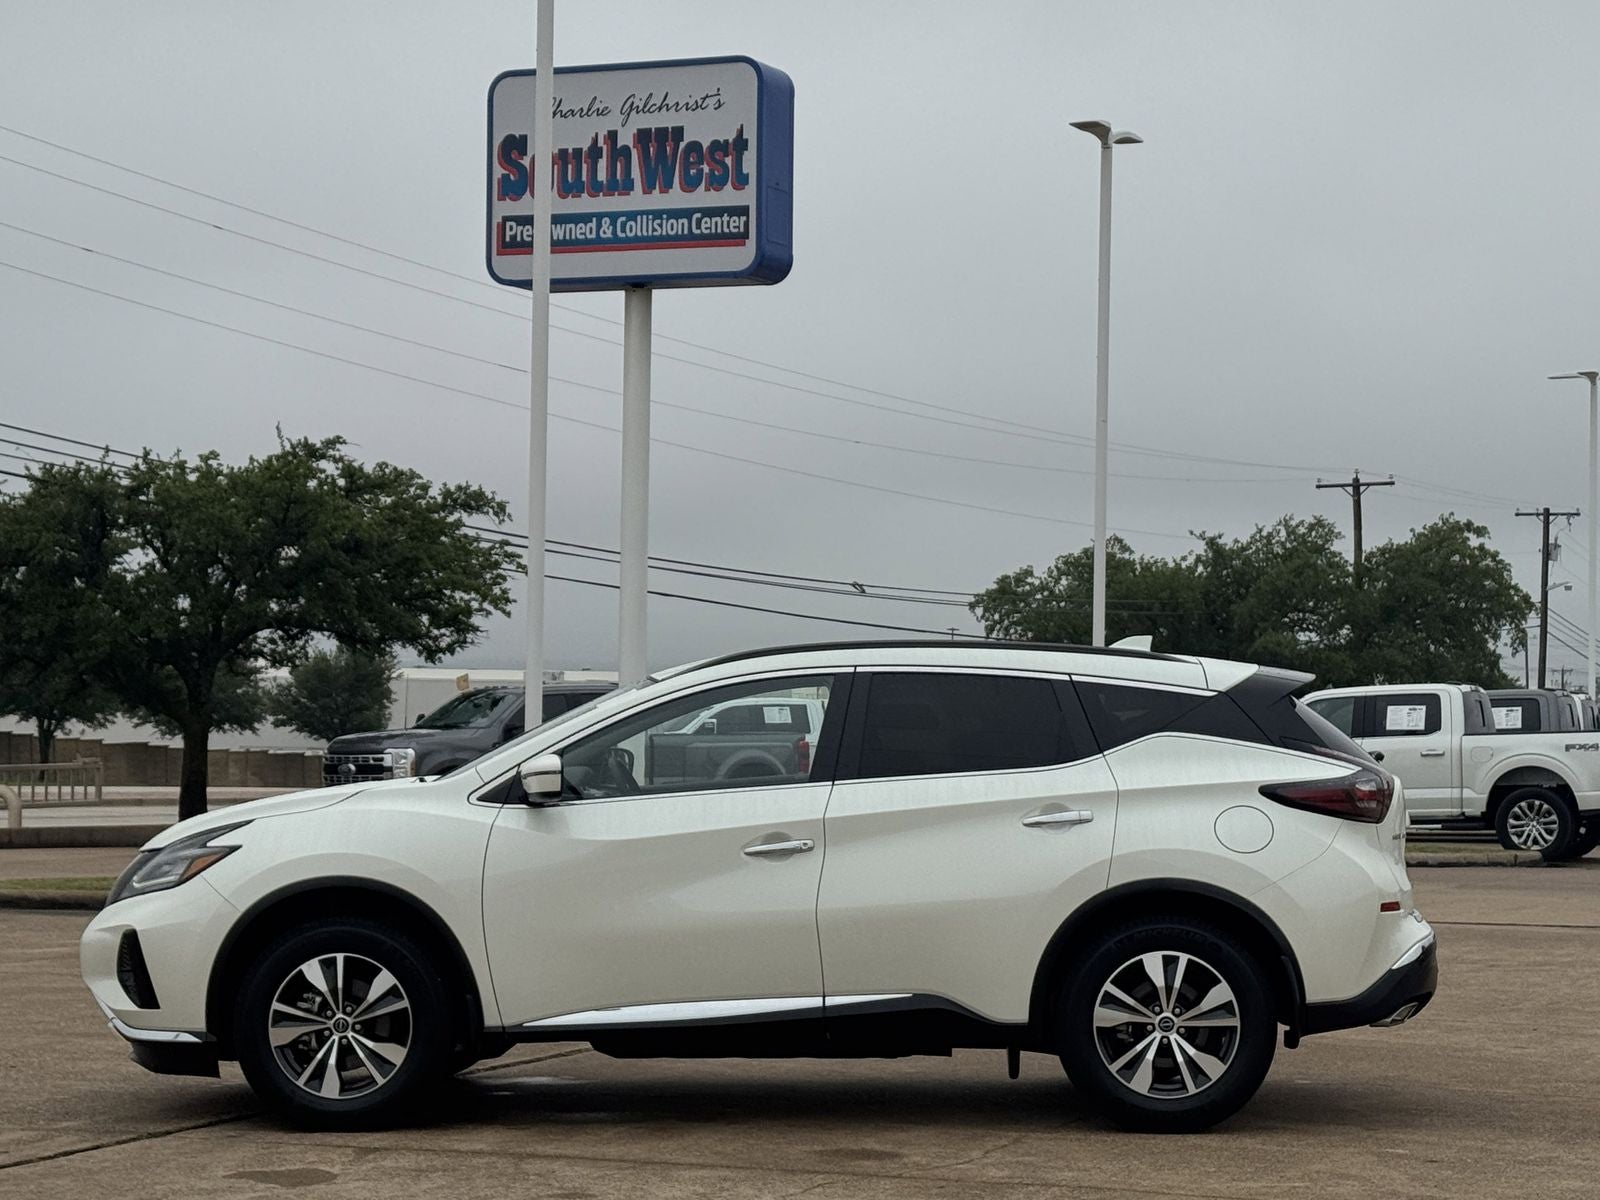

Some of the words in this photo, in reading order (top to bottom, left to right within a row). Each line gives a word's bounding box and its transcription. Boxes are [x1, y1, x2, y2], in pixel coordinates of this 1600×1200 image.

[552, 95, 612, 119] harlie
[619, 87, 726, 127] Gilchrist's
[496, 123, 750, 202] SuthWest
[505, 216, 597, 243] Prewned
[599, 217, 613, 240] &
[616, 214, 689, 238] Collision
[691, 212, 748, 235] Center
[1565, 743, 1599, 752] FX4
